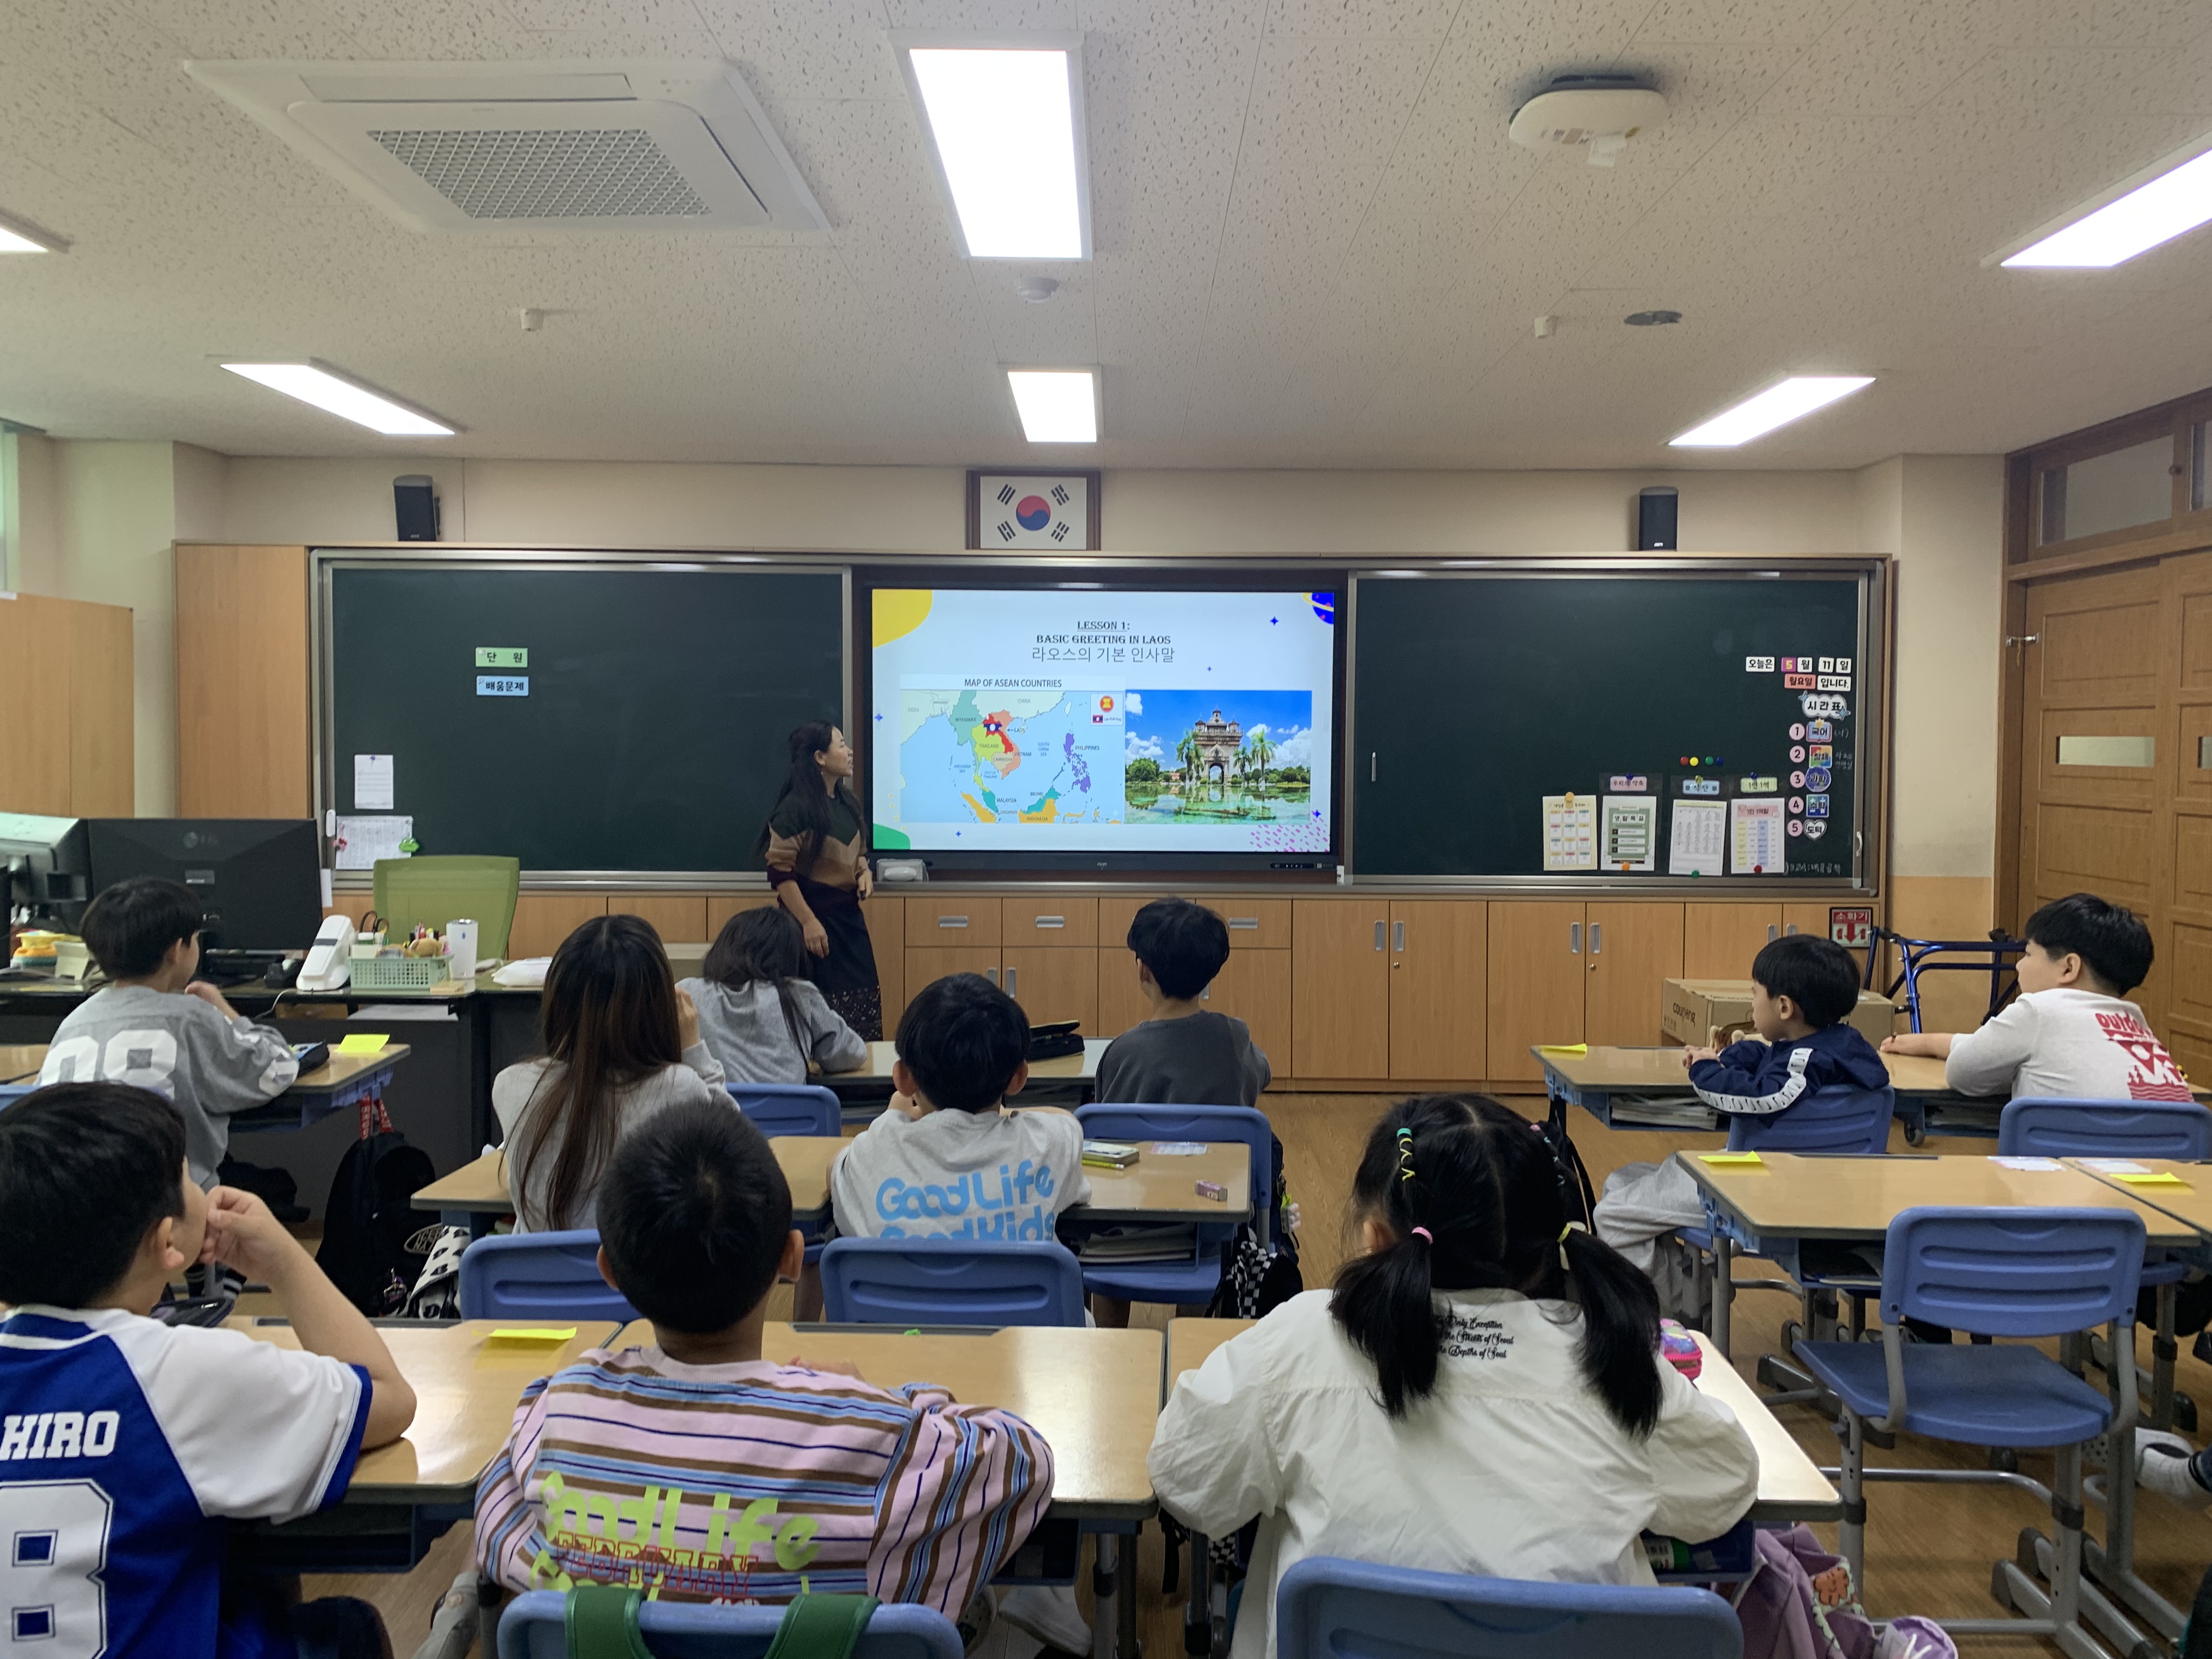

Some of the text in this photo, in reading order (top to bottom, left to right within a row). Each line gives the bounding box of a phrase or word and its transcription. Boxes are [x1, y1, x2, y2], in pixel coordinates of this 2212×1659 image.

[1077, 621, 1130, 630] LESSON 1:
[1036, 635, 1171, 644] BASIC GREETING IN LAOS
[1032, 646, 1175, 663] 라오스의 기본 인사말
[1748, 658, 1849, 670] 오늘은 5 월 11 일
[964, 679, 1062, 687] MAP OF ASEAN COUNTRIES
[1789, 676, 1813, 686] 월요일
[1795, 726, 1799, 736] 1
[1794, 749, 1801, 759] 2
[1794, 774, 1801, 784] 3
[1793, 800, 1799, 809] 4
[1792, 823, 1798, 833] 5
